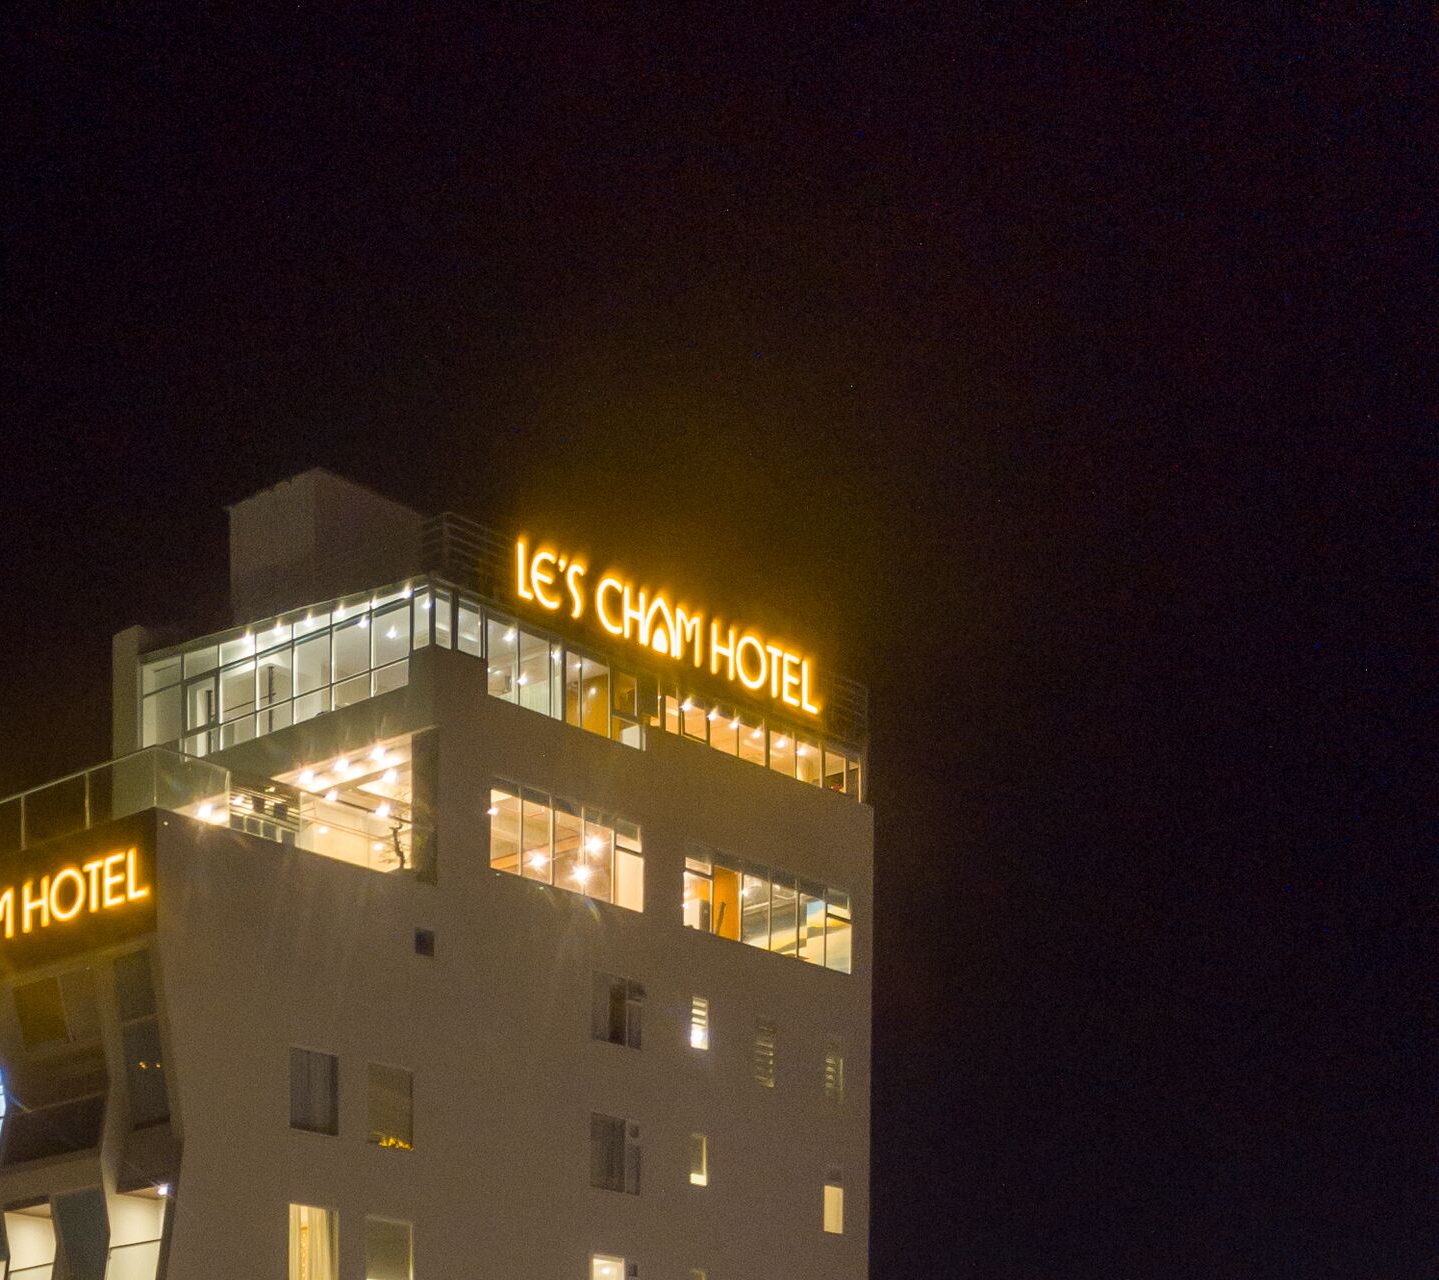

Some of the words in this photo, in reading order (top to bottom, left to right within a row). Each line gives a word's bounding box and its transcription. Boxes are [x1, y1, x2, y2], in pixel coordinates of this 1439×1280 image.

[516, 539, 586, 619] LE'S
[595, 576, 702, 669] CHAM
[710, 619, 820, 715] HOTEL
[21, 847, 151, 934] HOTEL
